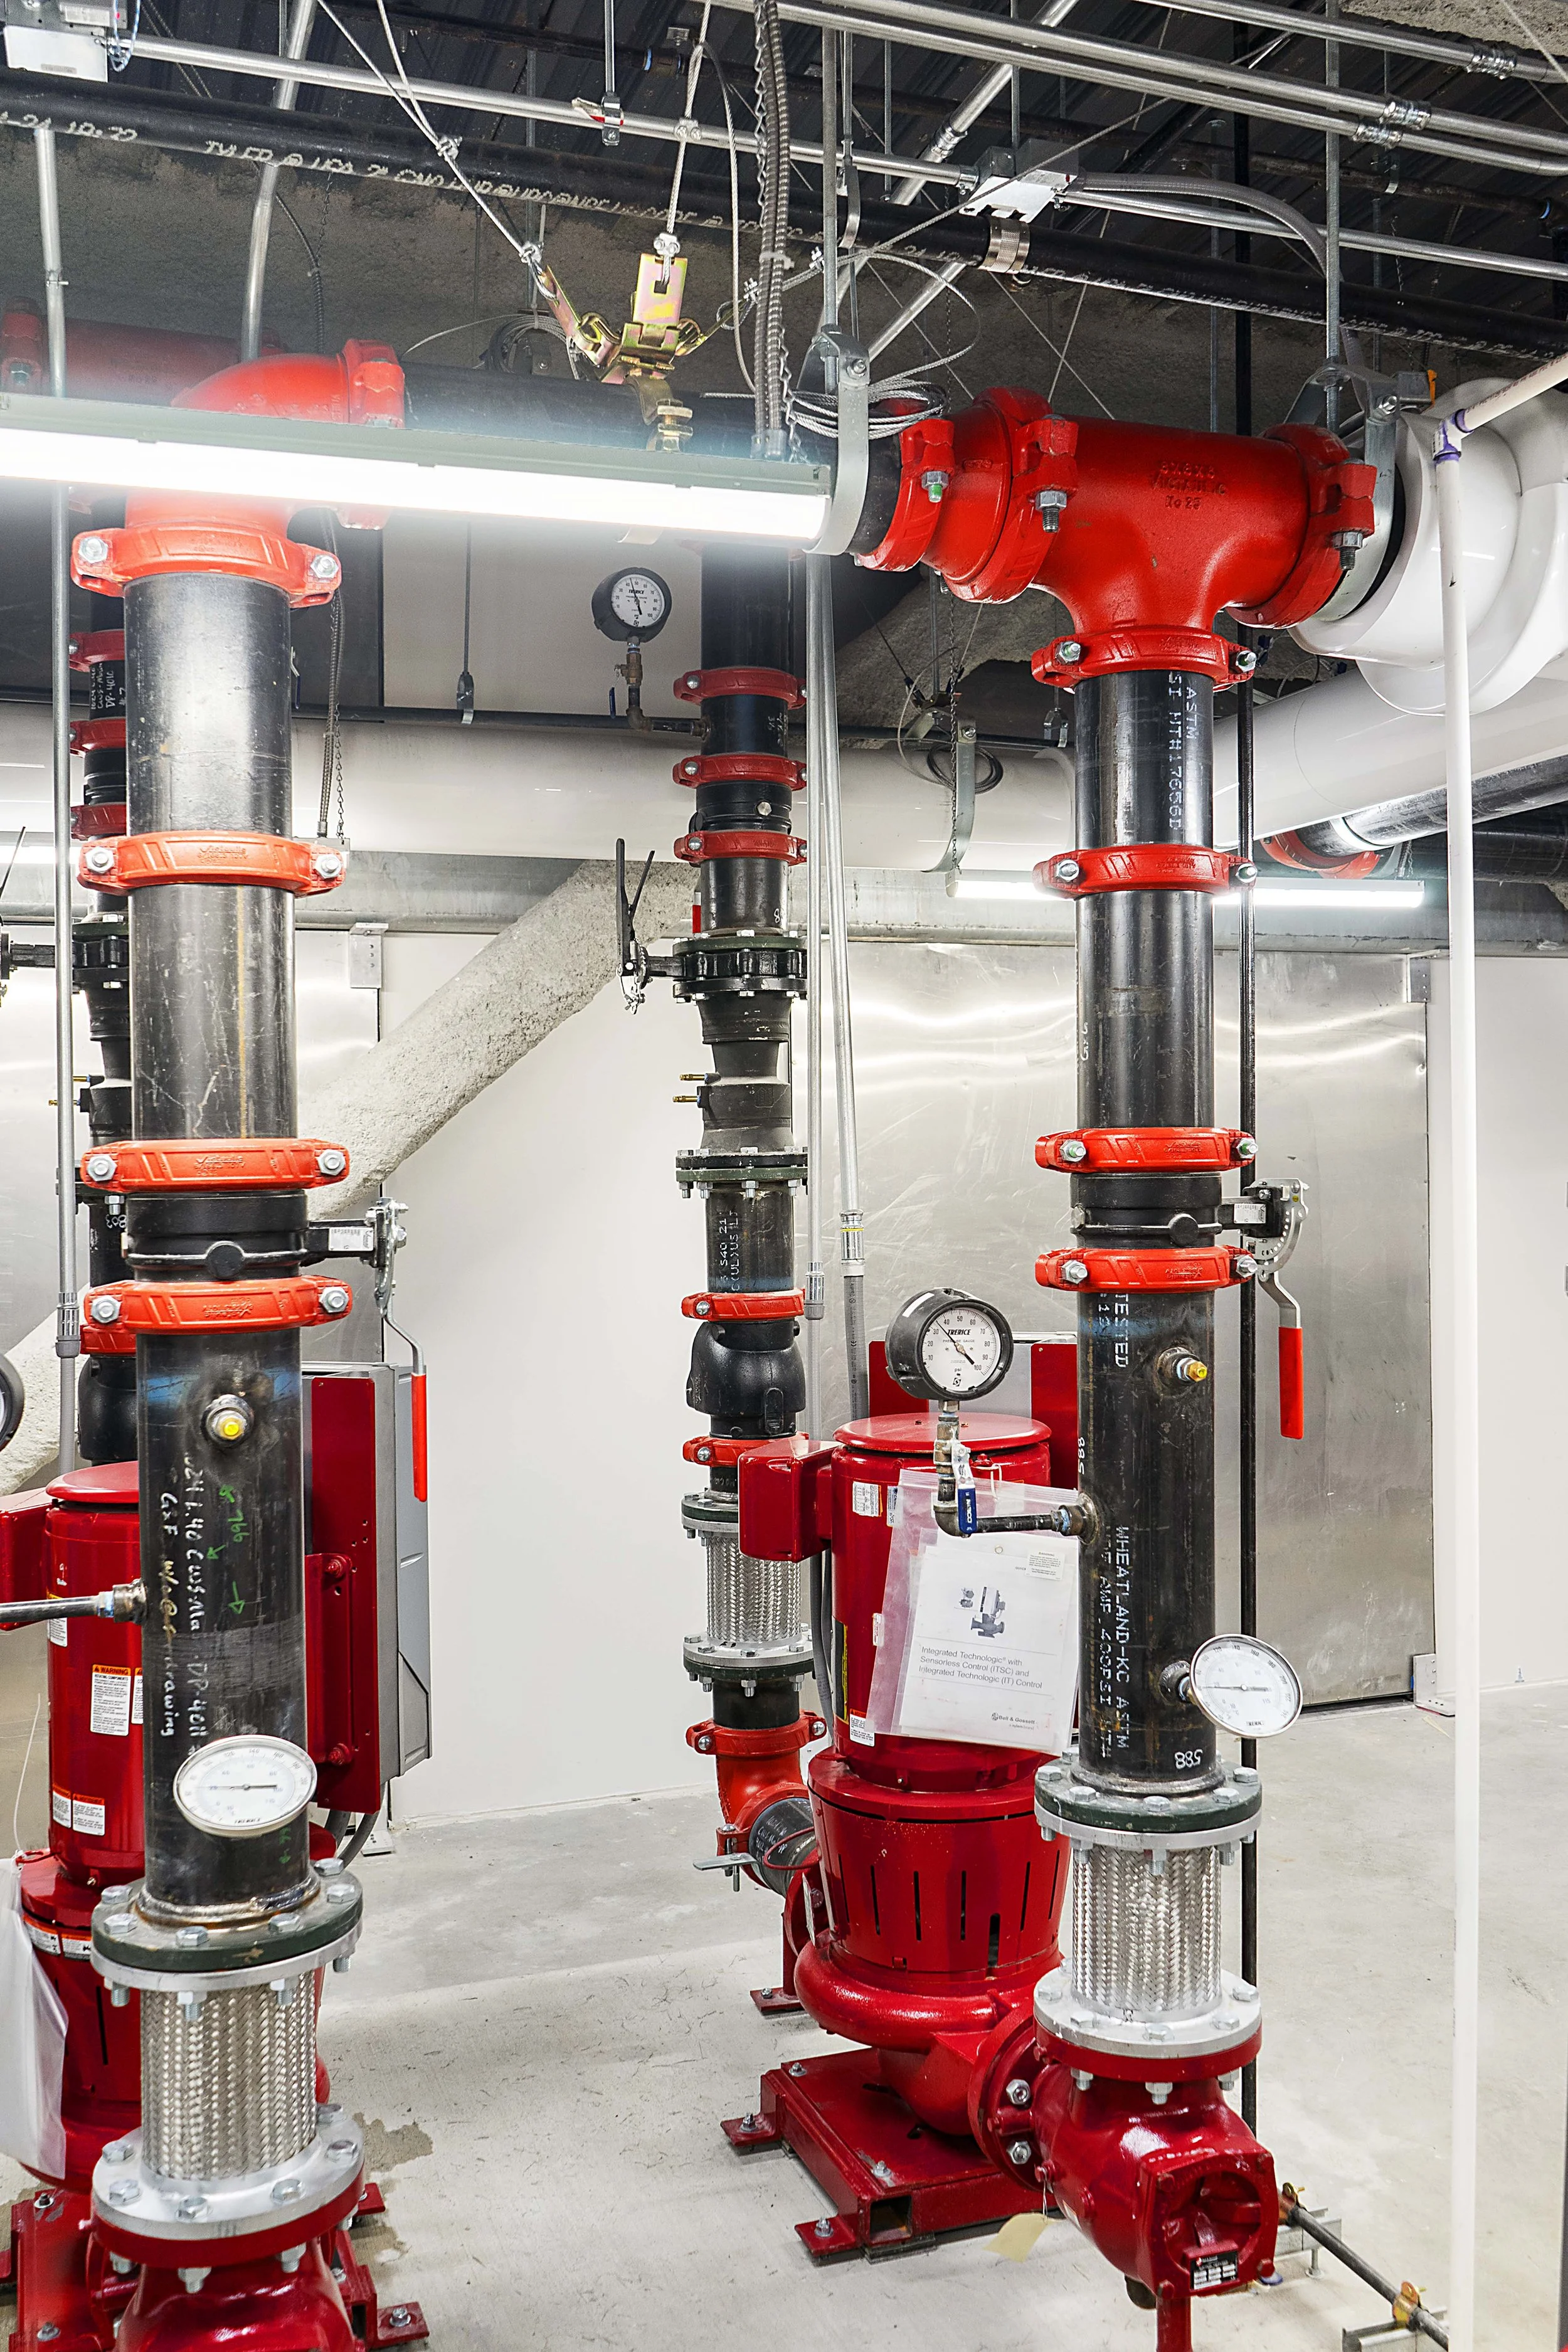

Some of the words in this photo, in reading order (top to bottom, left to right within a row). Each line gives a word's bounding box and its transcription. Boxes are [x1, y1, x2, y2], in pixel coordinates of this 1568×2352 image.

[1186, 686, 1197, 739] ASTM
[921, 1646, 958, 1658] Integrated
[919, 1665, 955, 1677] Integrated
[957, 1670, 1000, 1683] Technologic
[1001, 1676, 1014, 1686] (IT)
[1015, 1678, 1042, 1688] Control
[920, 1656, 960, 1667] Sensorless
[962, 1661, 988, 1671] Control
[990, 1665, 1014, 1676] (ITSC)
[1174, 1749, 1203, 1770] 588
